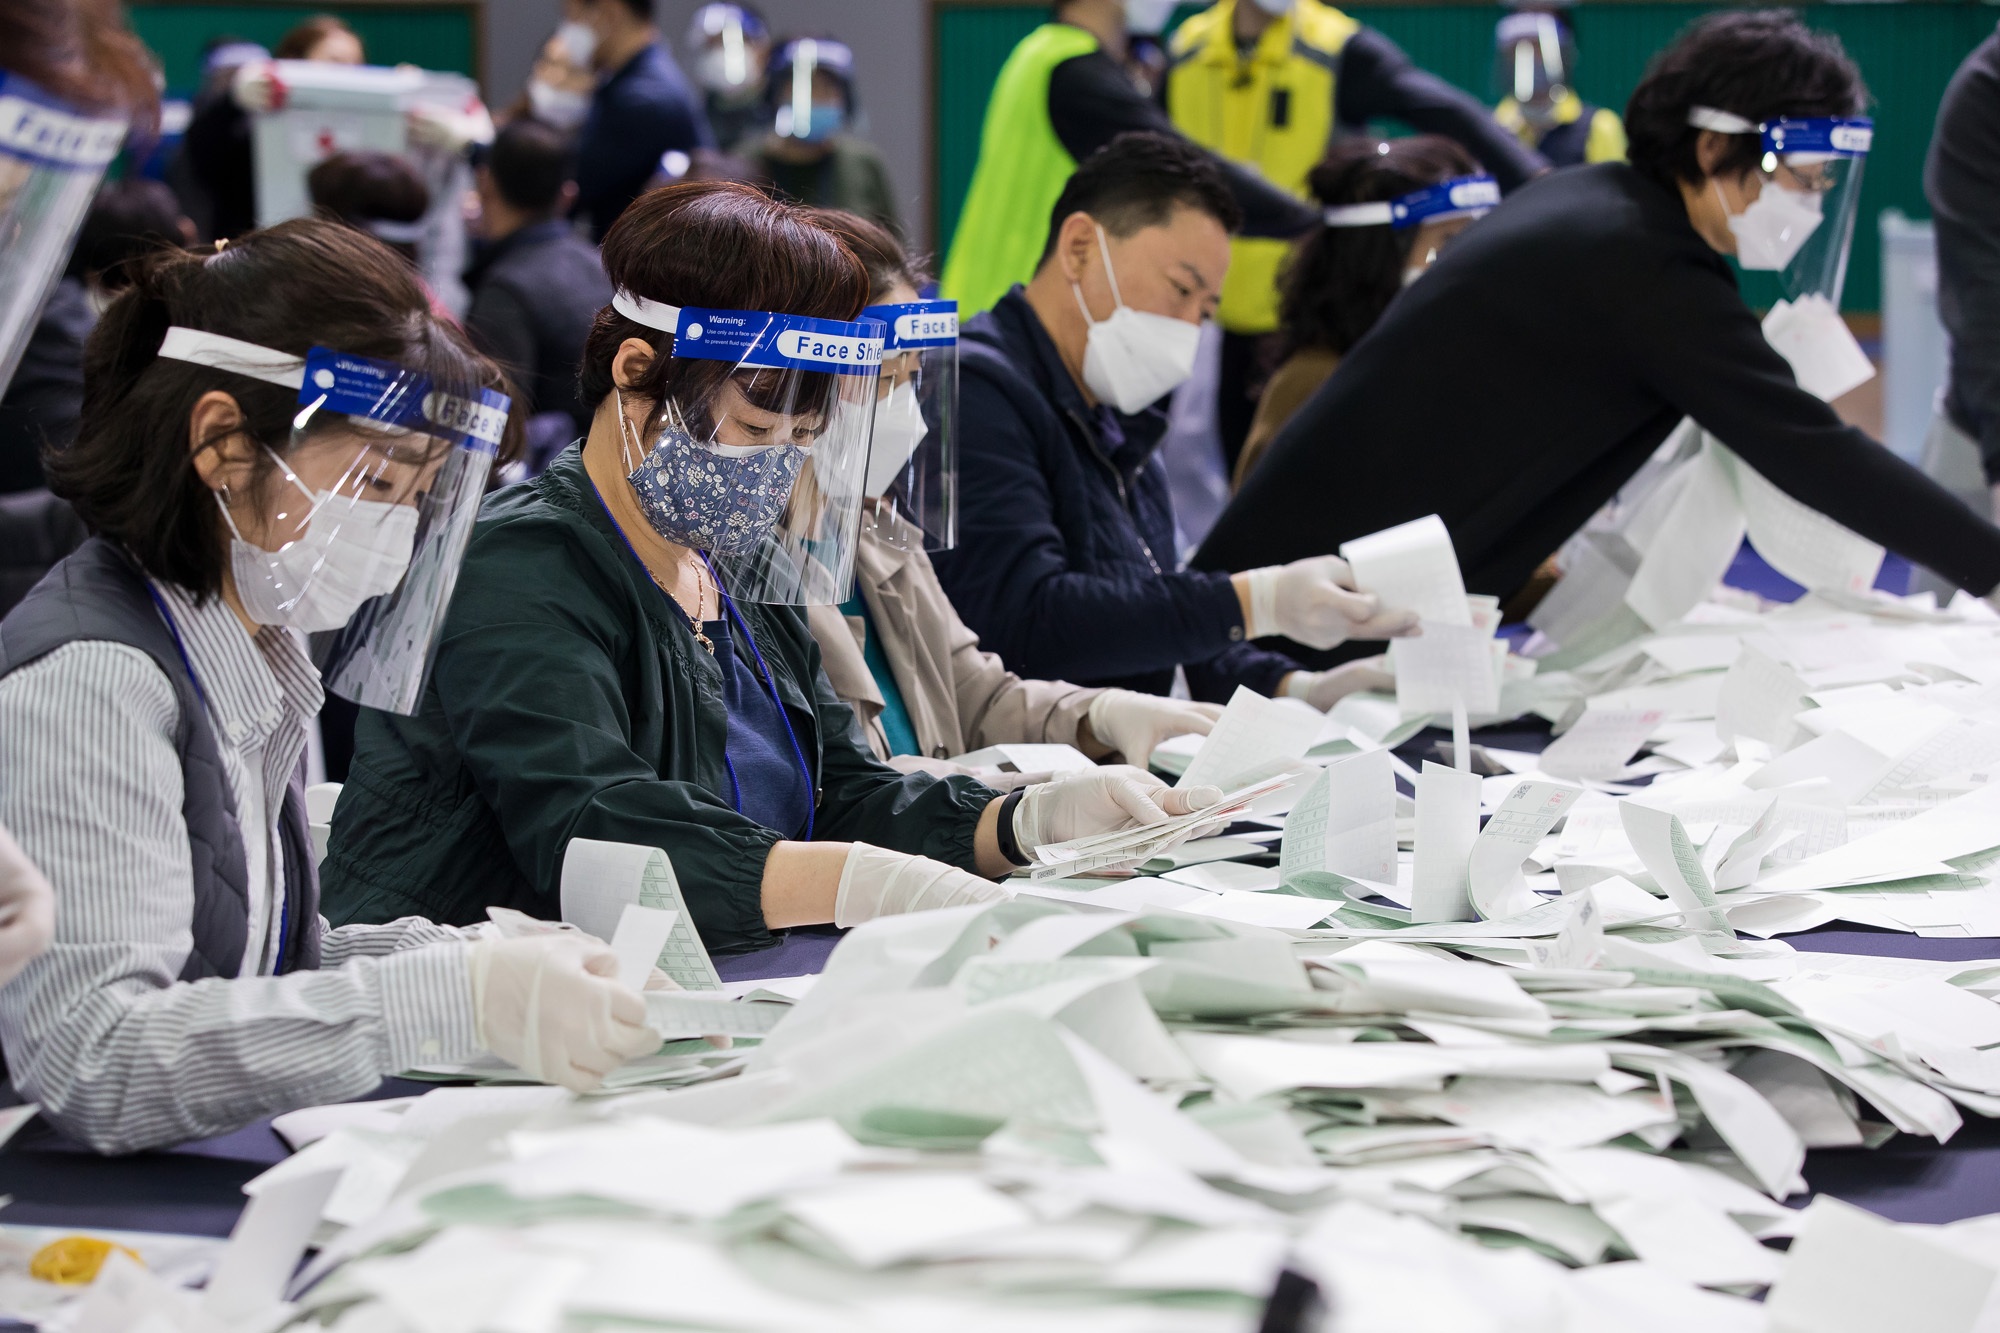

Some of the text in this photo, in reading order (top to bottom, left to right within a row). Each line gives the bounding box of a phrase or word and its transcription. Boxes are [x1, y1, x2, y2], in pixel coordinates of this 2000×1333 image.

[709, 315, 747, 327] Warning:
[911, 319, 946, 334] Face
[797, 336, 849, 359] Face
[442, 400, 489, 433] Face
